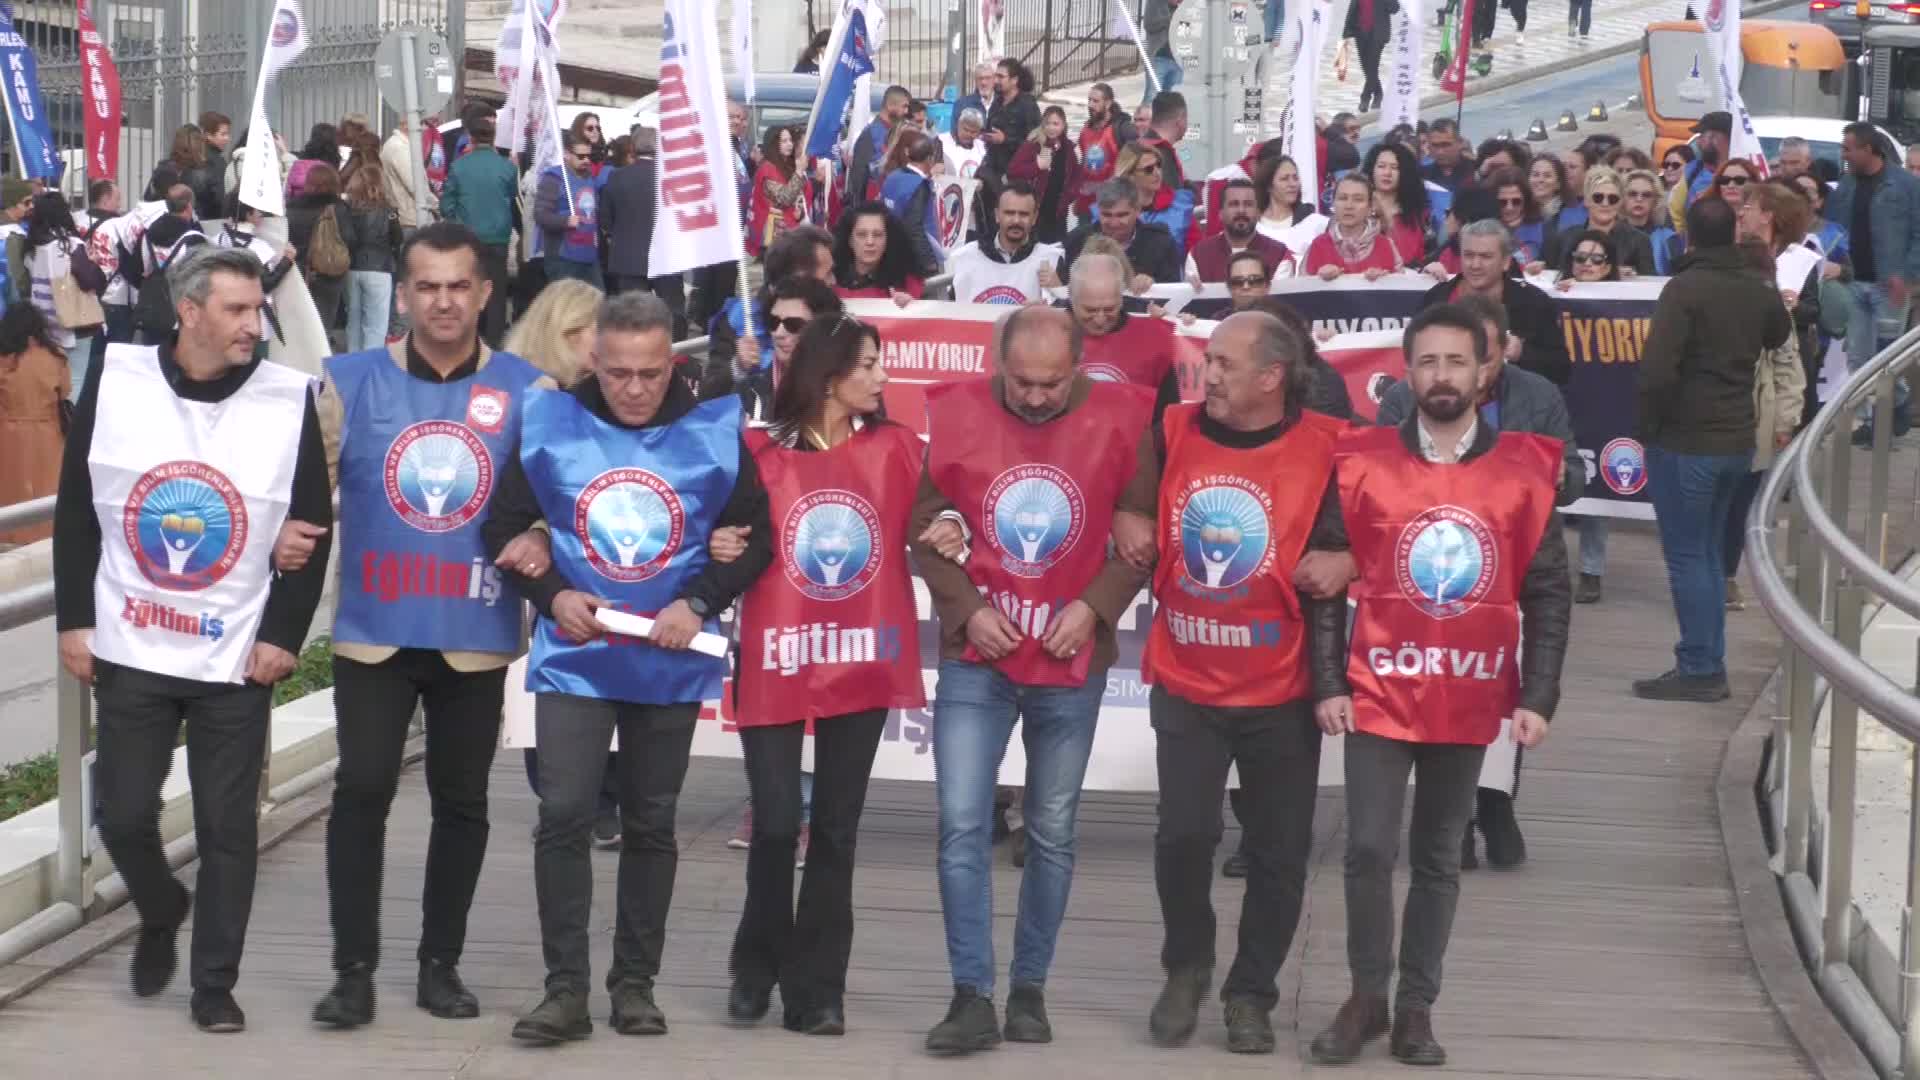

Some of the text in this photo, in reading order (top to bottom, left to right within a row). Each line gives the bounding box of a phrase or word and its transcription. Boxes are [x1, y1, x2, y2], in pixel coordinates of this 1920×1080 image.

[8, 53, 35, 121] KAMU
[86, 49, 110, 119] KAMU
[1368, 641, 1505, 680] GÖRVLİ
